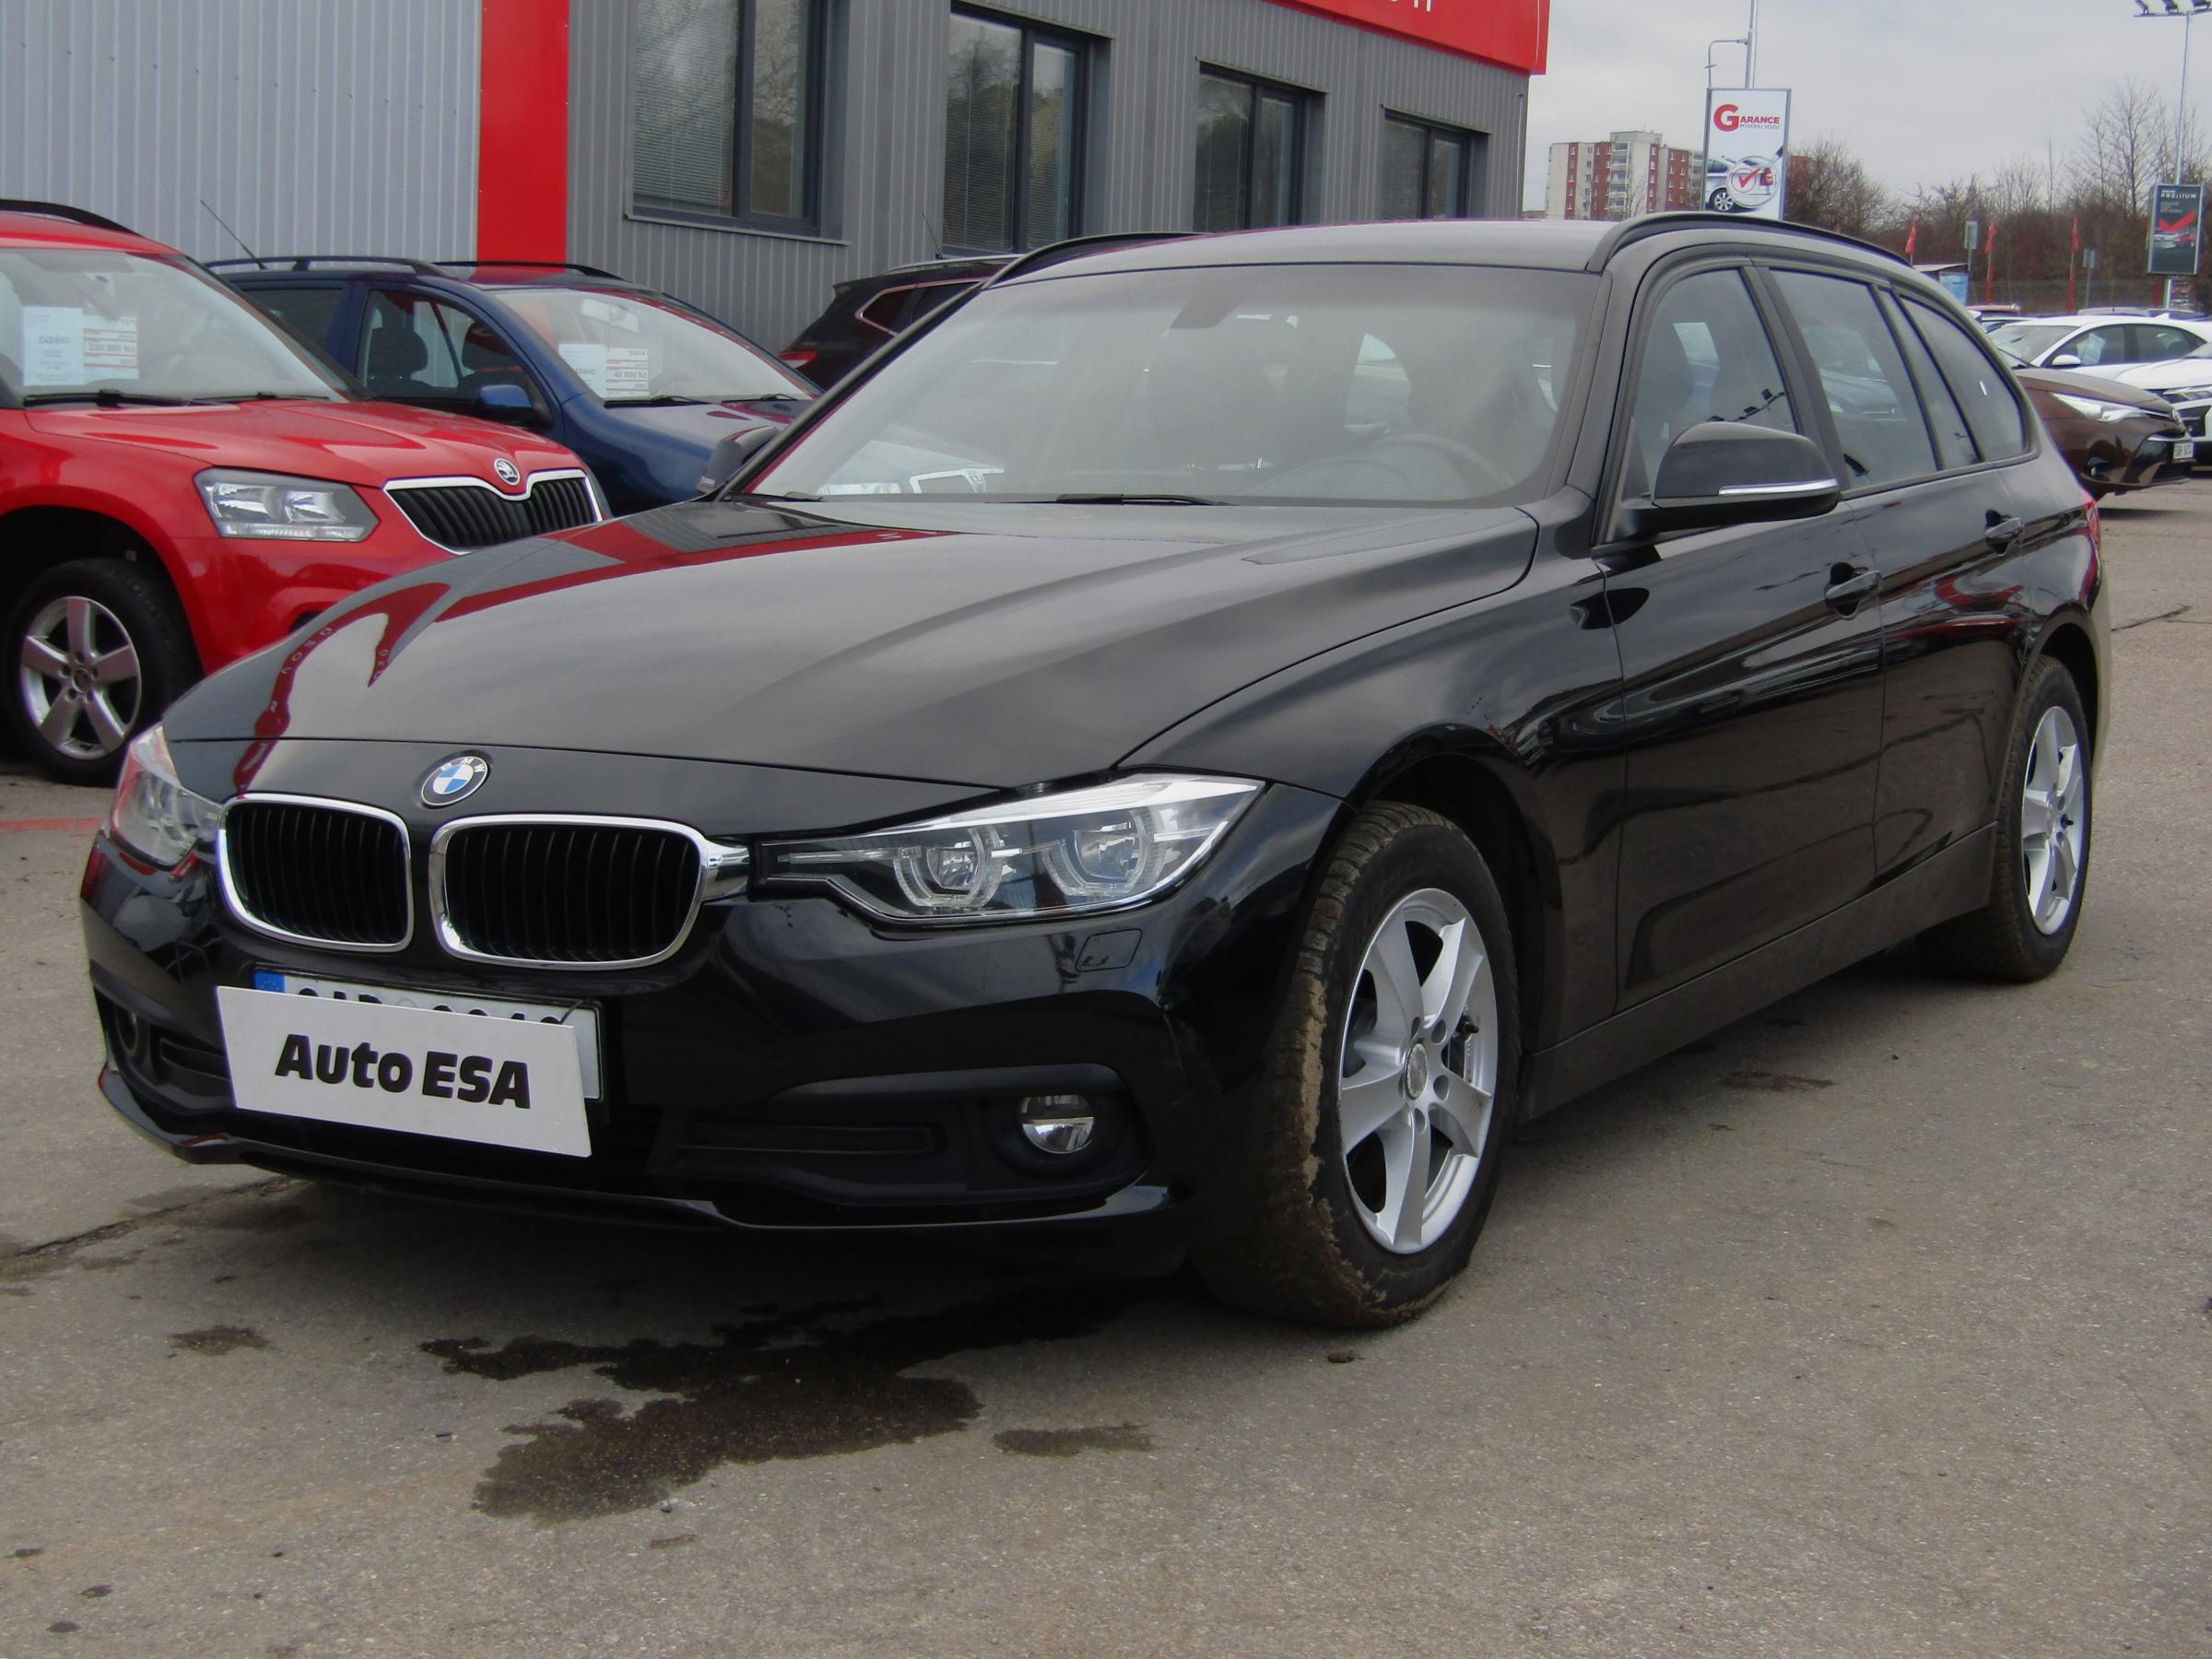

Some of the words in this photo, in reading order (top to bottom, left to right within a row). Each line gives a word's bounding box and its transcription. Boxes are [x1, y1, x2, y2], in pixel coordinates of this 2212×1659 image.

[1713, 104, 1780, 132] GARANCE
[441, 758, 486, 773] BMW
[275, 1033, 414, 1093] Auto
[421, 1051, 532, 1110] ESA
